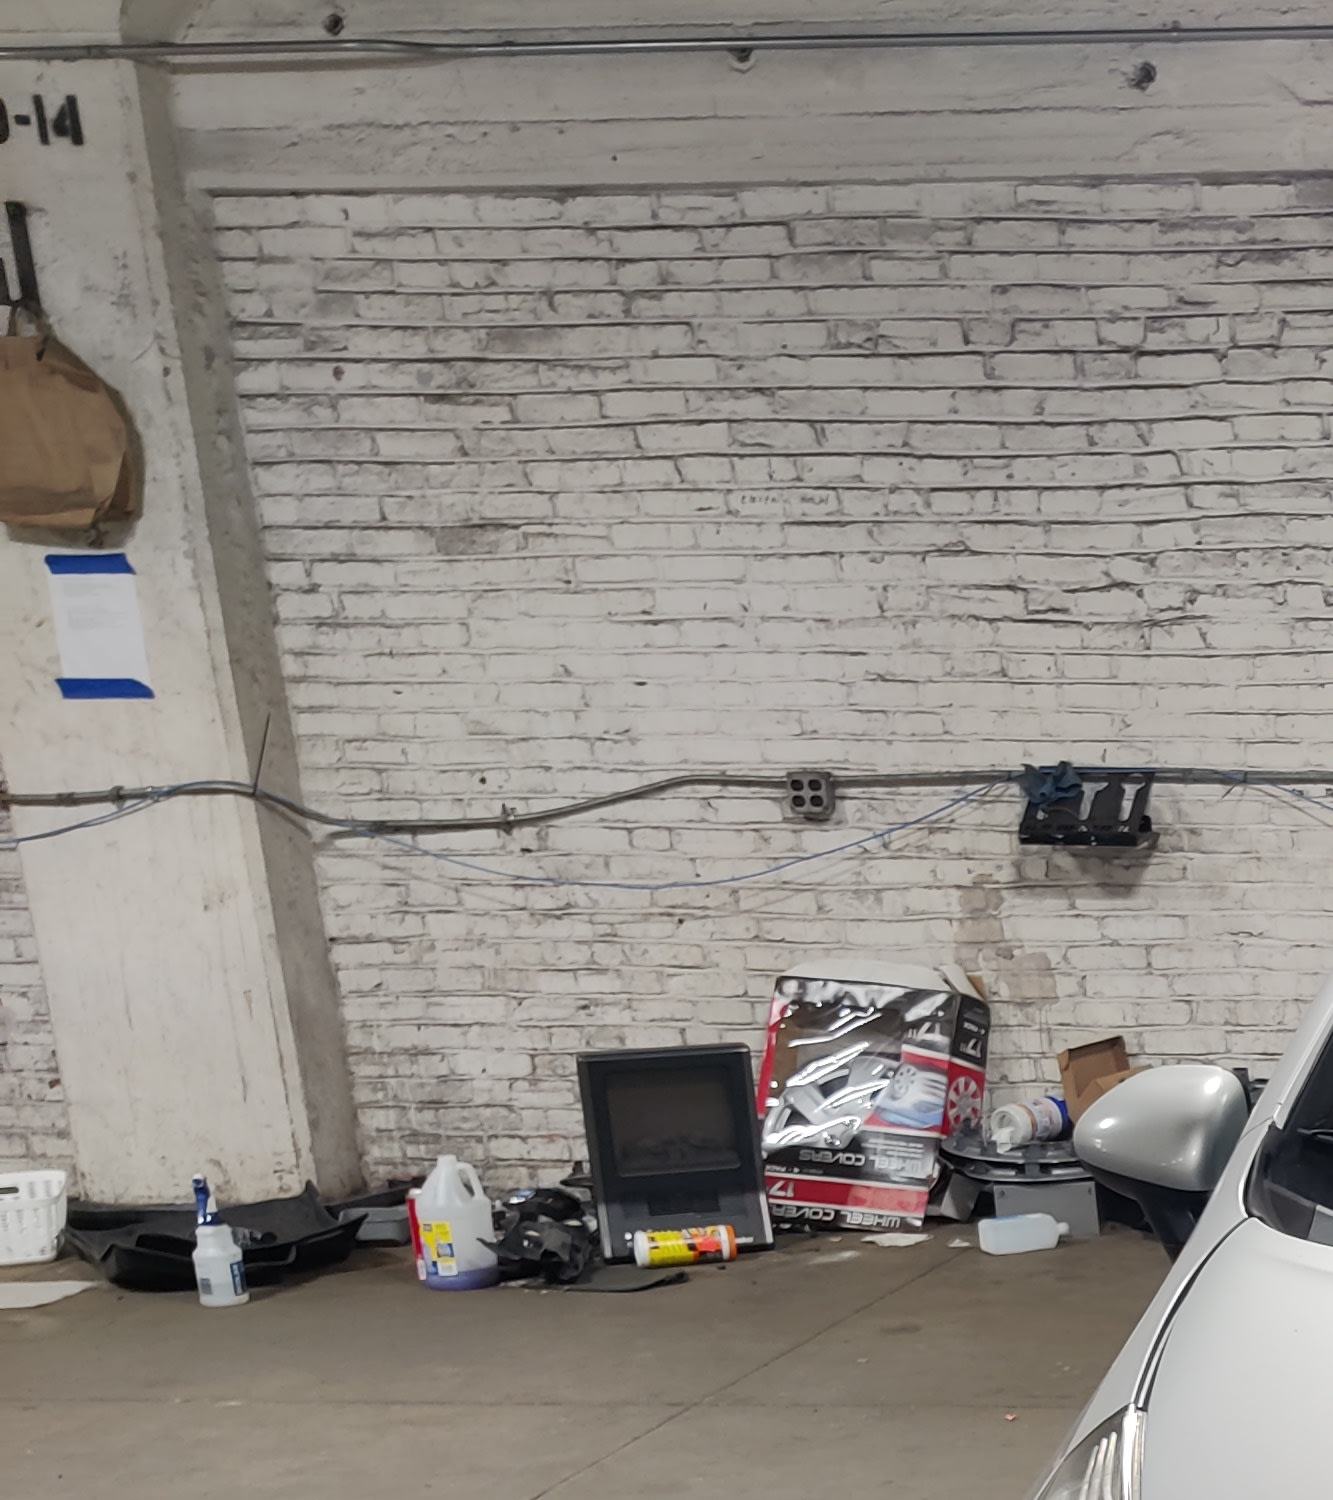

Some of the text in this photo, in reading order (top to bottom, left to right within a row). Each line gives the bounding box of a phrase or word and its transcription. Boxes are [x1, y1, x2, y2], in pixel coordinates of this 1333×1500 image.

[800, 1150, 921, 1172] WHEEL COVERS
[772, 1204, 900, 1229] WHEEL COVER
